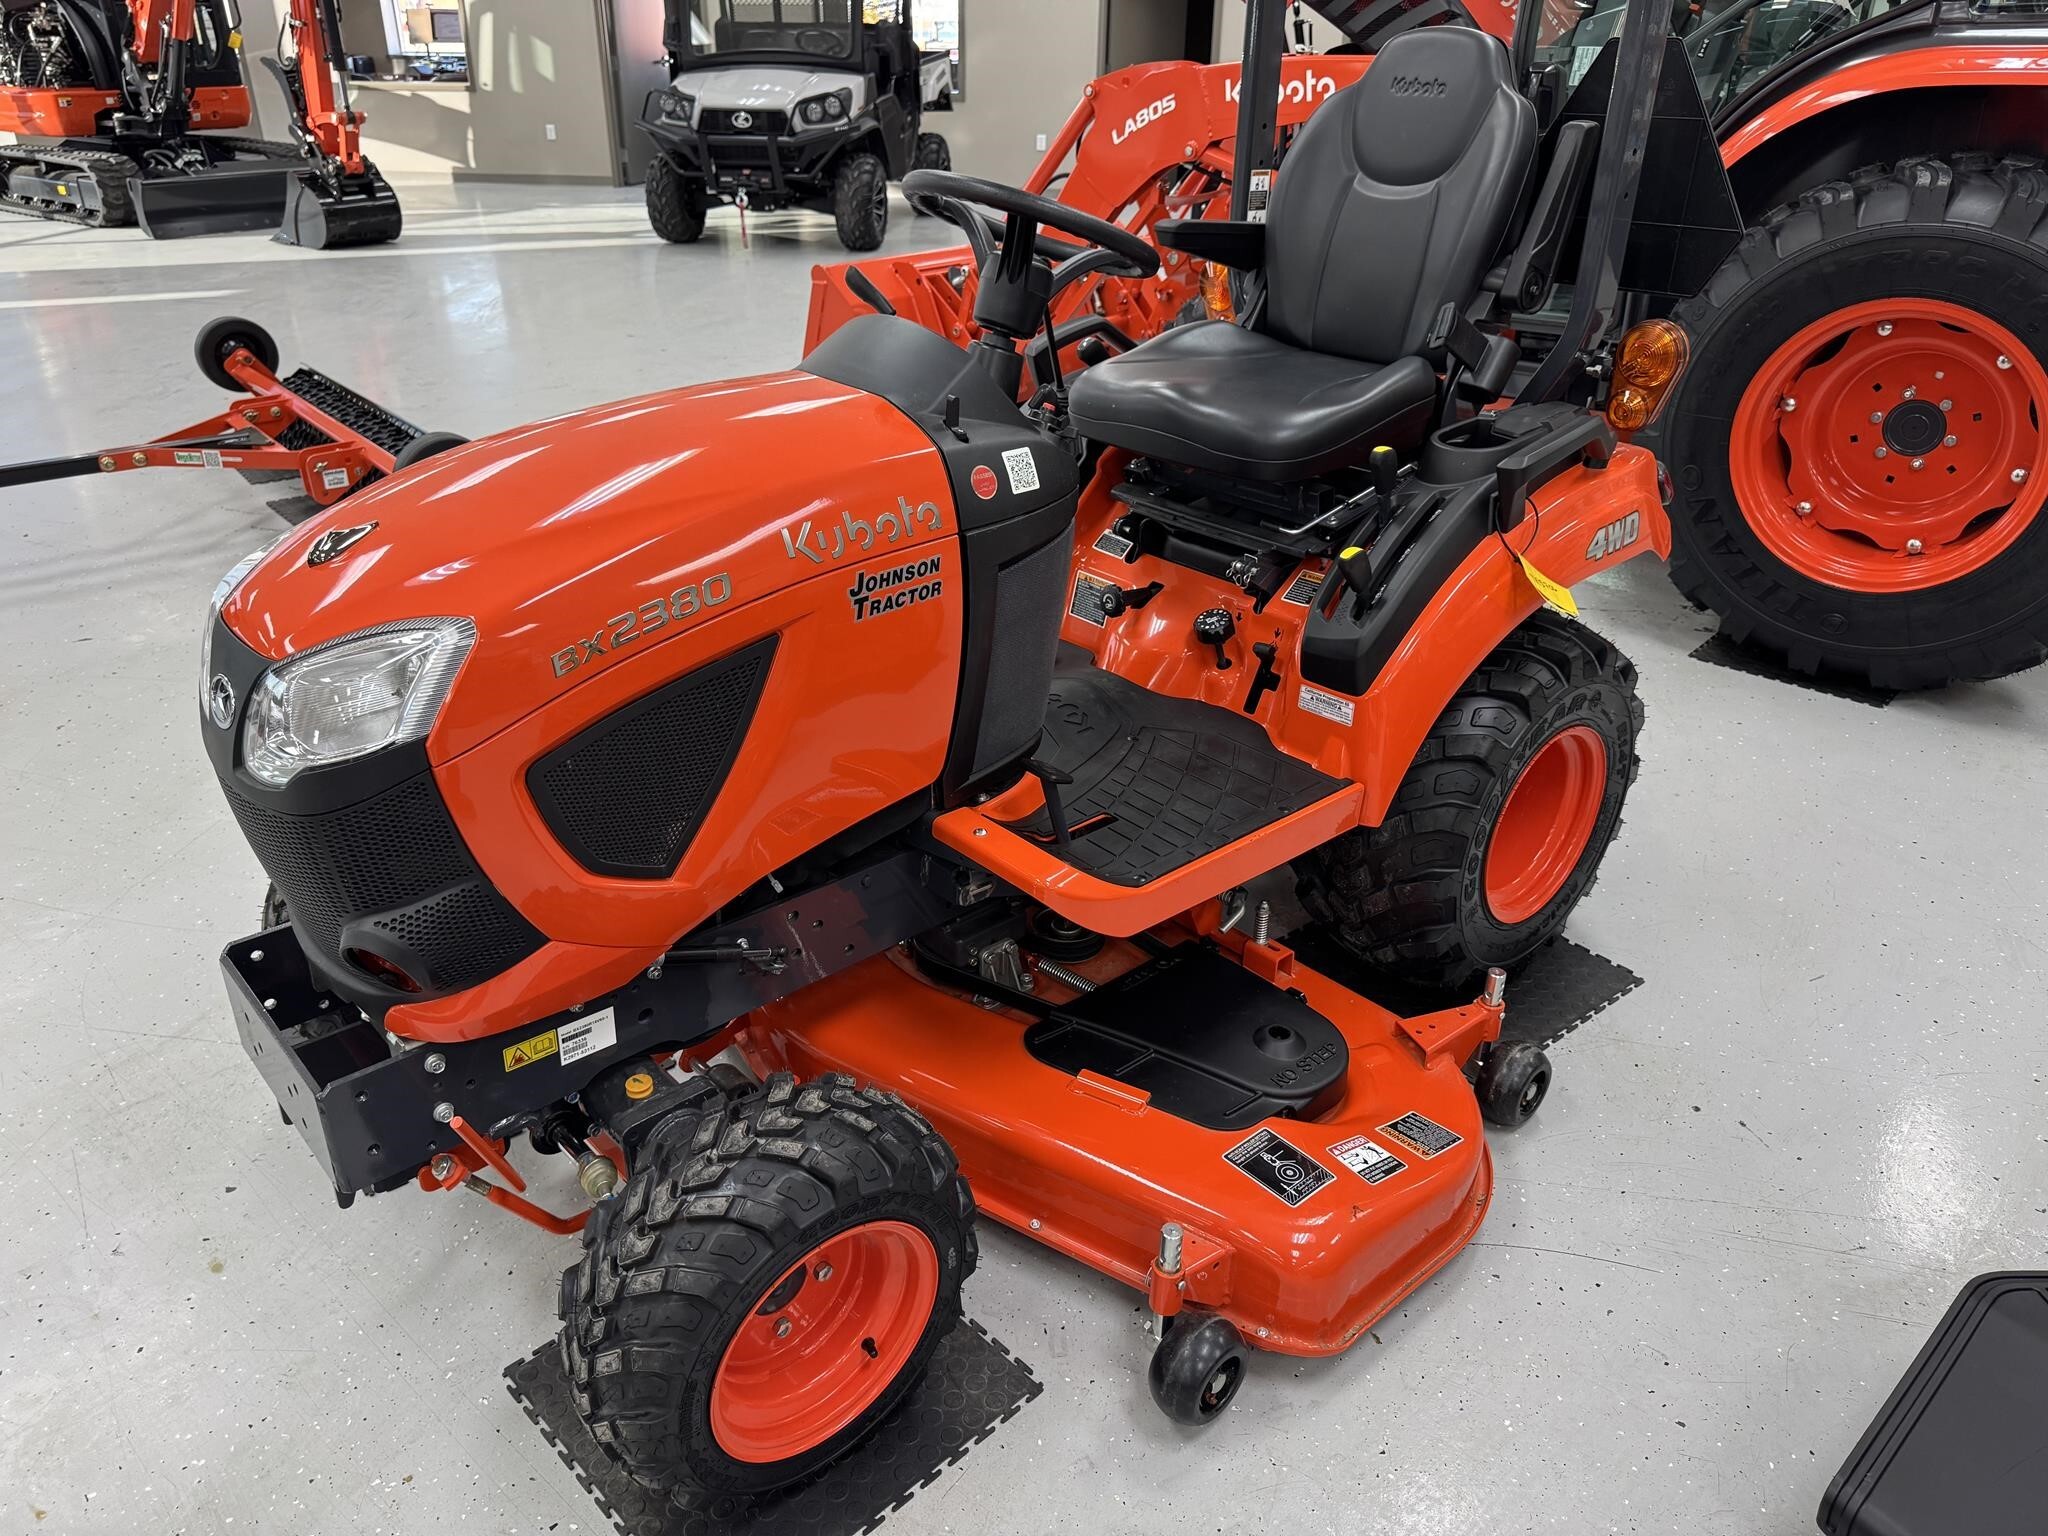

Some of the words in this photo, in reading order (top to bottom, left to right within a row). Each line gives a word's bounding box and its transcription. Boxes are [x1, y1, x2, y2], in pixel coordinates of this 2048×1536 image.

[1224, 69, 1336, 105] Kota
[1390, 75, 1448, 98] Kubota
[1111, 93, 1177, 145] LA805
[780, 496, 943, 564] Kubota
[1585, 510, 1641, 562] 4WD
[849, 554, 943, 598] JOHNSON
[852, 581, 943, 622] TRACTOR
[550, 571, 732, 679] BX2380
[1270, 1069, 1299, 1088] NO
[1296, 1043, 1337, 1073] STEP
[1337, 1137, 1369, 1153] DANGER
[1380, 1126, 1424, 1154] WARNING
